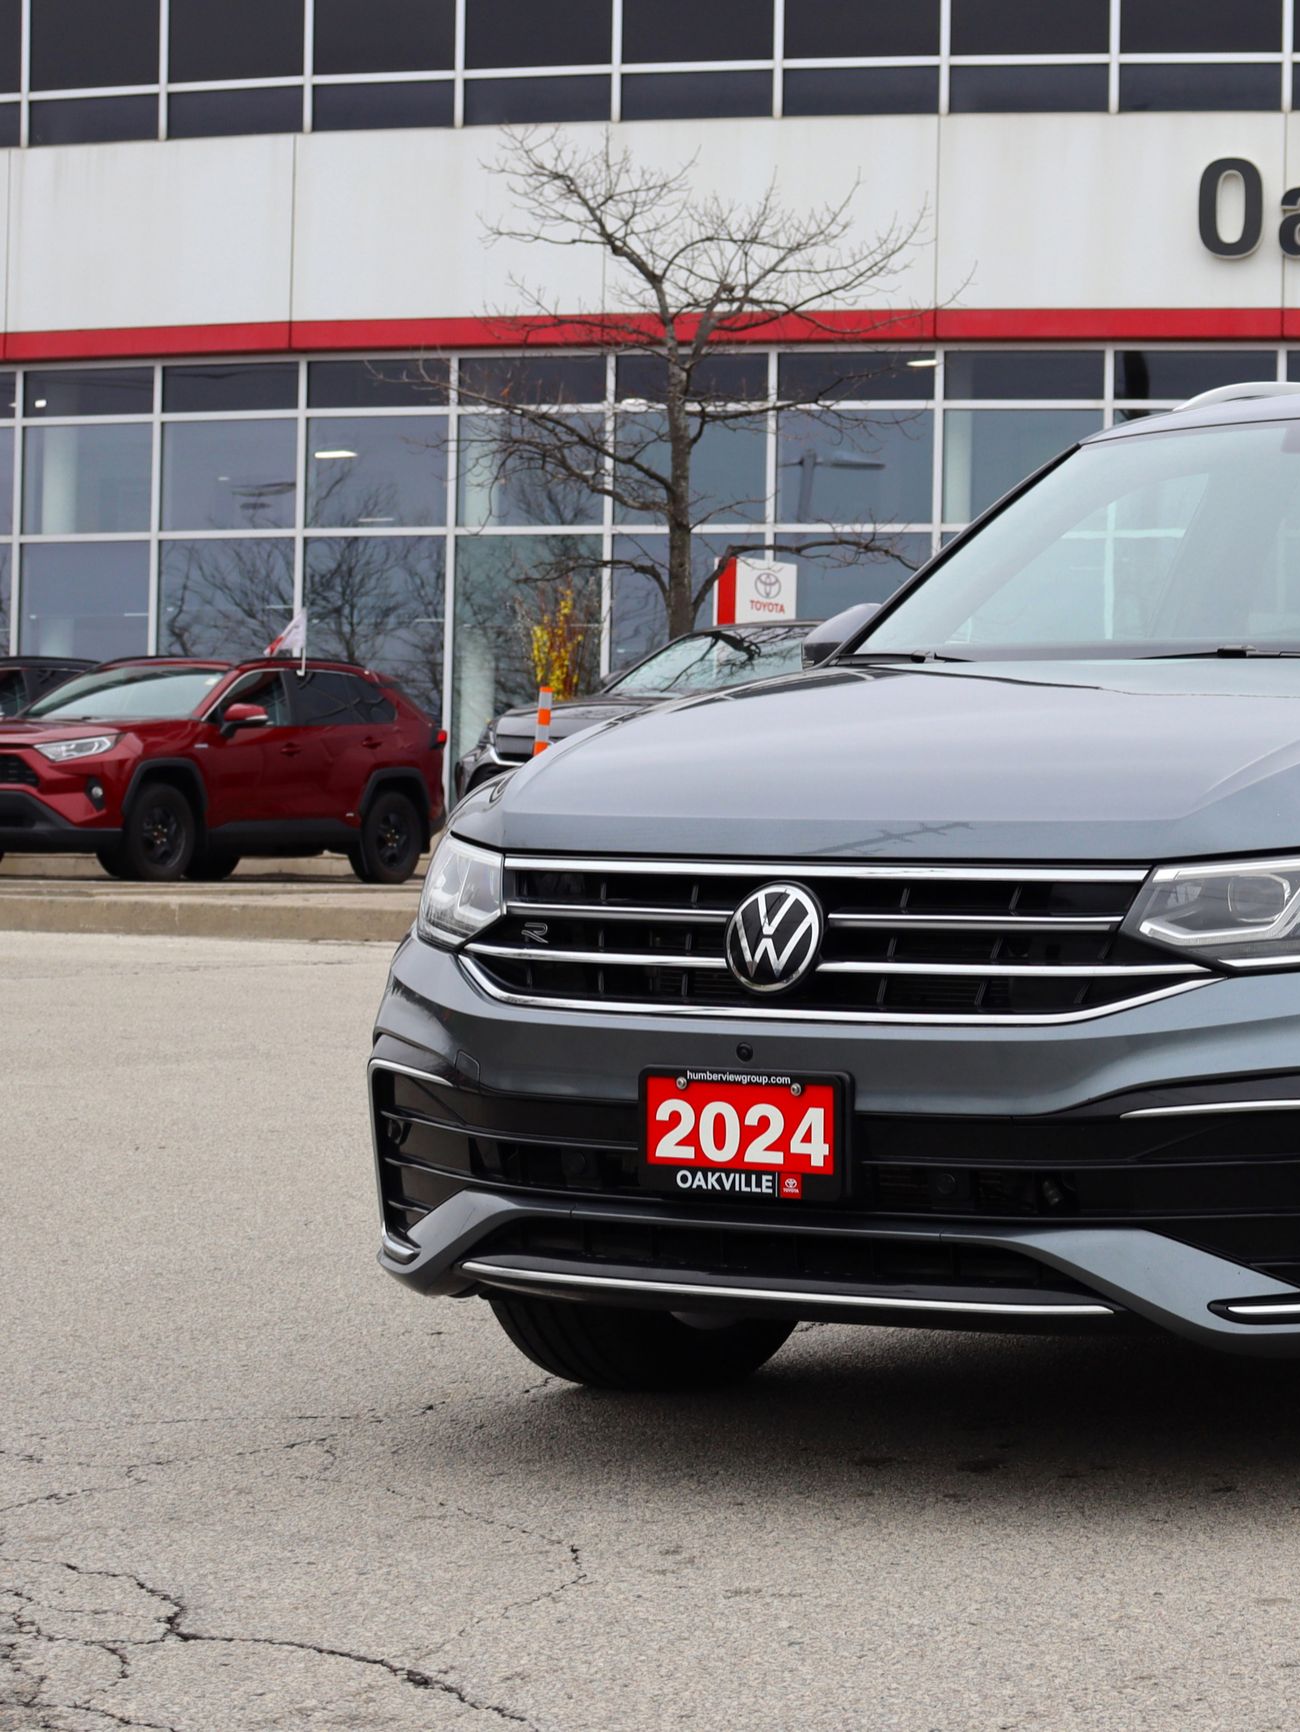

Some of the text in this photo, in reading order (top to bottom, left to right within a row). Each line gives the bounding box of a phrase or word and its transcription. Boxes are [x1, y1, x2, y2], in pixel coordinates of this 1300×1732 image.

[750, 600, 785, 614] TOYOTA
[687, 1070, 791, 1085] humberviewgroup.com
[655, 1098, 829, 1167] 2024
[676, 1170, 773, 1193] OAKVILLE
